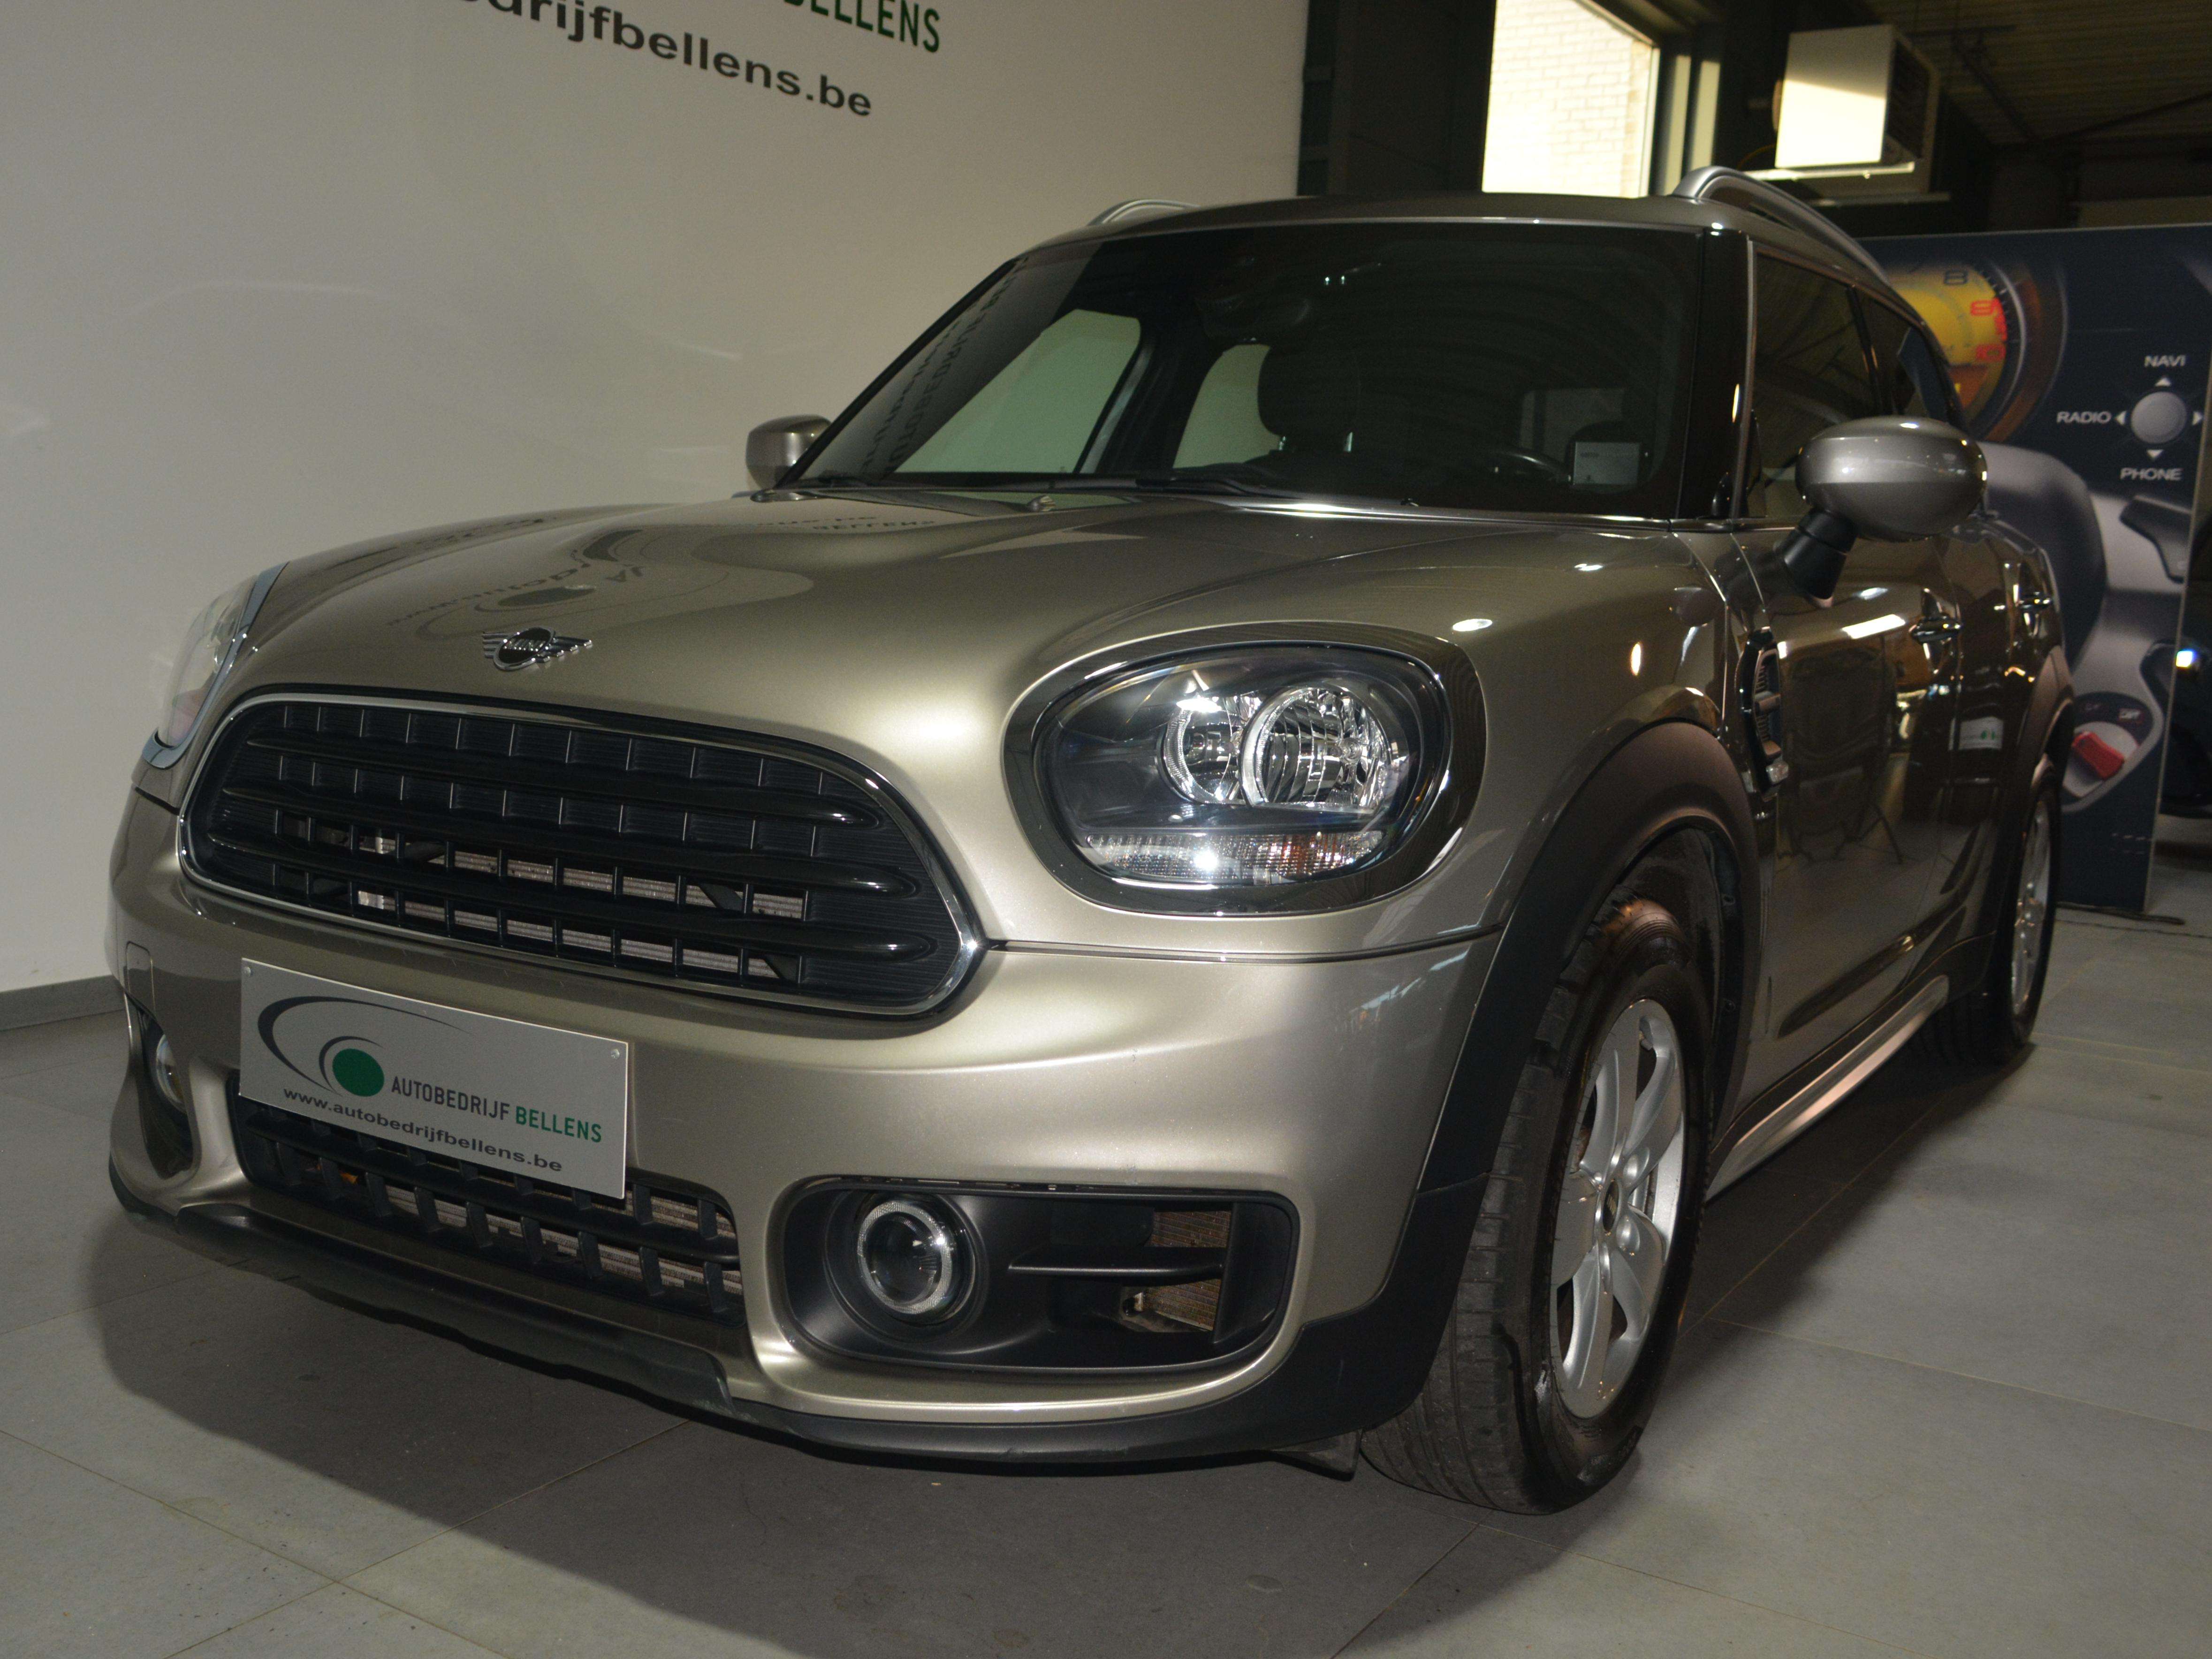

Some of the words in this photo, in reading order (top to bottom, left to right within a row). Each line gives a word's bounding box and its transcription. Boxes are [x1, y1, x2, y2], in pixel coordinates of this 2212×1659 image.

[2144, 355, 2186, 367] NAVI
[2056, 411, 2112, 424] RADIO
[2120, 468, 2183, 481] PHONE
[391, 1076, 510, 1121] AUTOBEDRIJF
[516, 1105, 602, 1143] BELLENS
[283, 1088, 563, 1172] www.autobedrijfbellens.be
